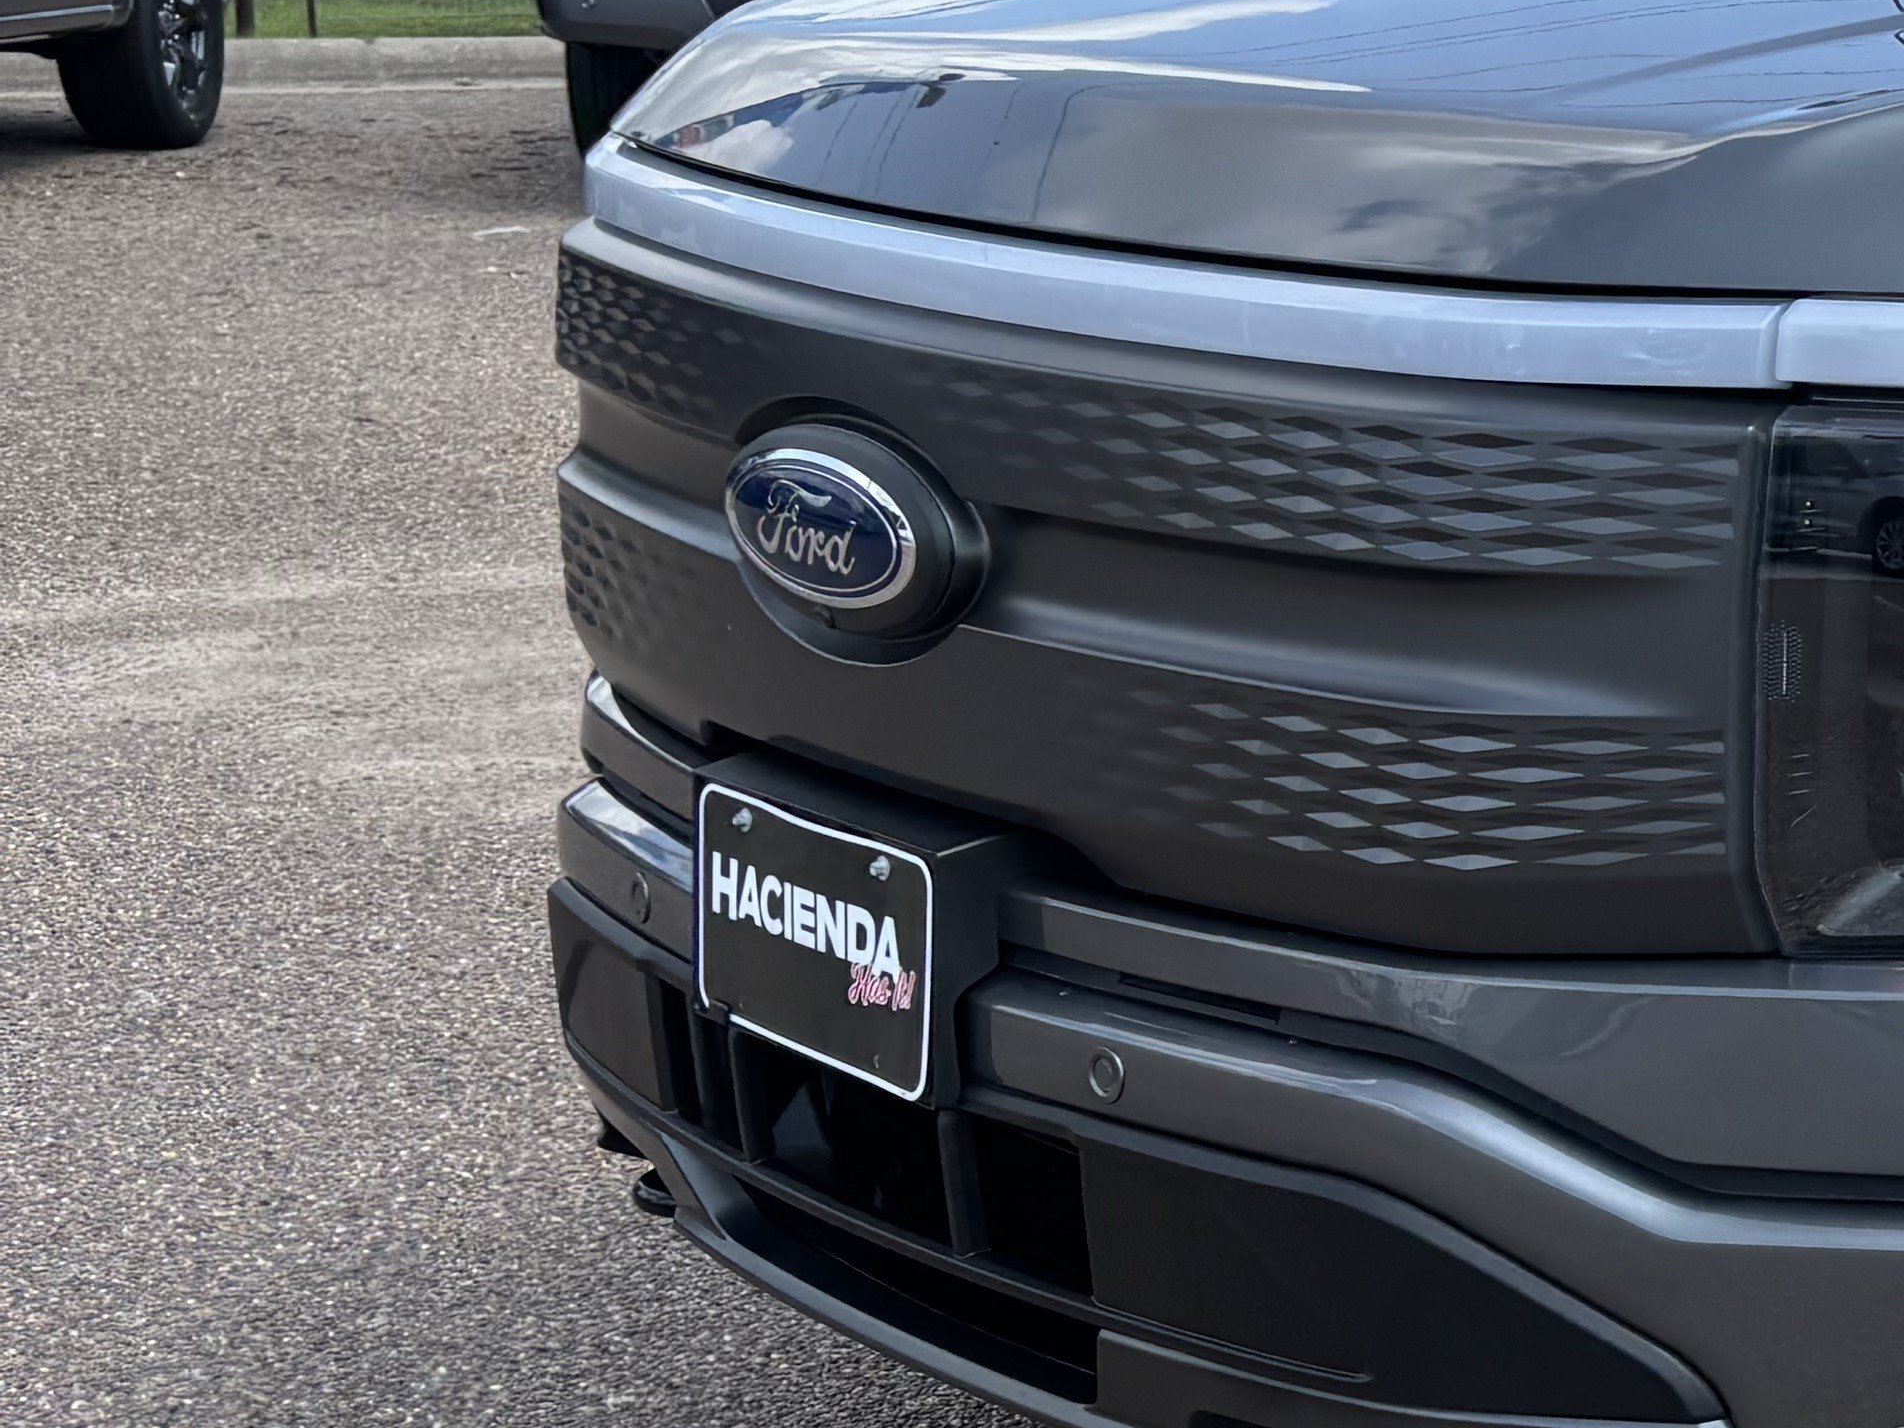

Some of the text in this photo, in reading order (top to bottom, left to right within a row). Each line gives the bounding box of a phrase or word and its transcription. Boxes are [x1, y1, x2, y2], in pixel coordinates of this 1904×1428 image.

[756, 478, 857, 576] Ford
[712, 851, 901, 984] HACIENDA
[847, 962, 892, 1006] Has
